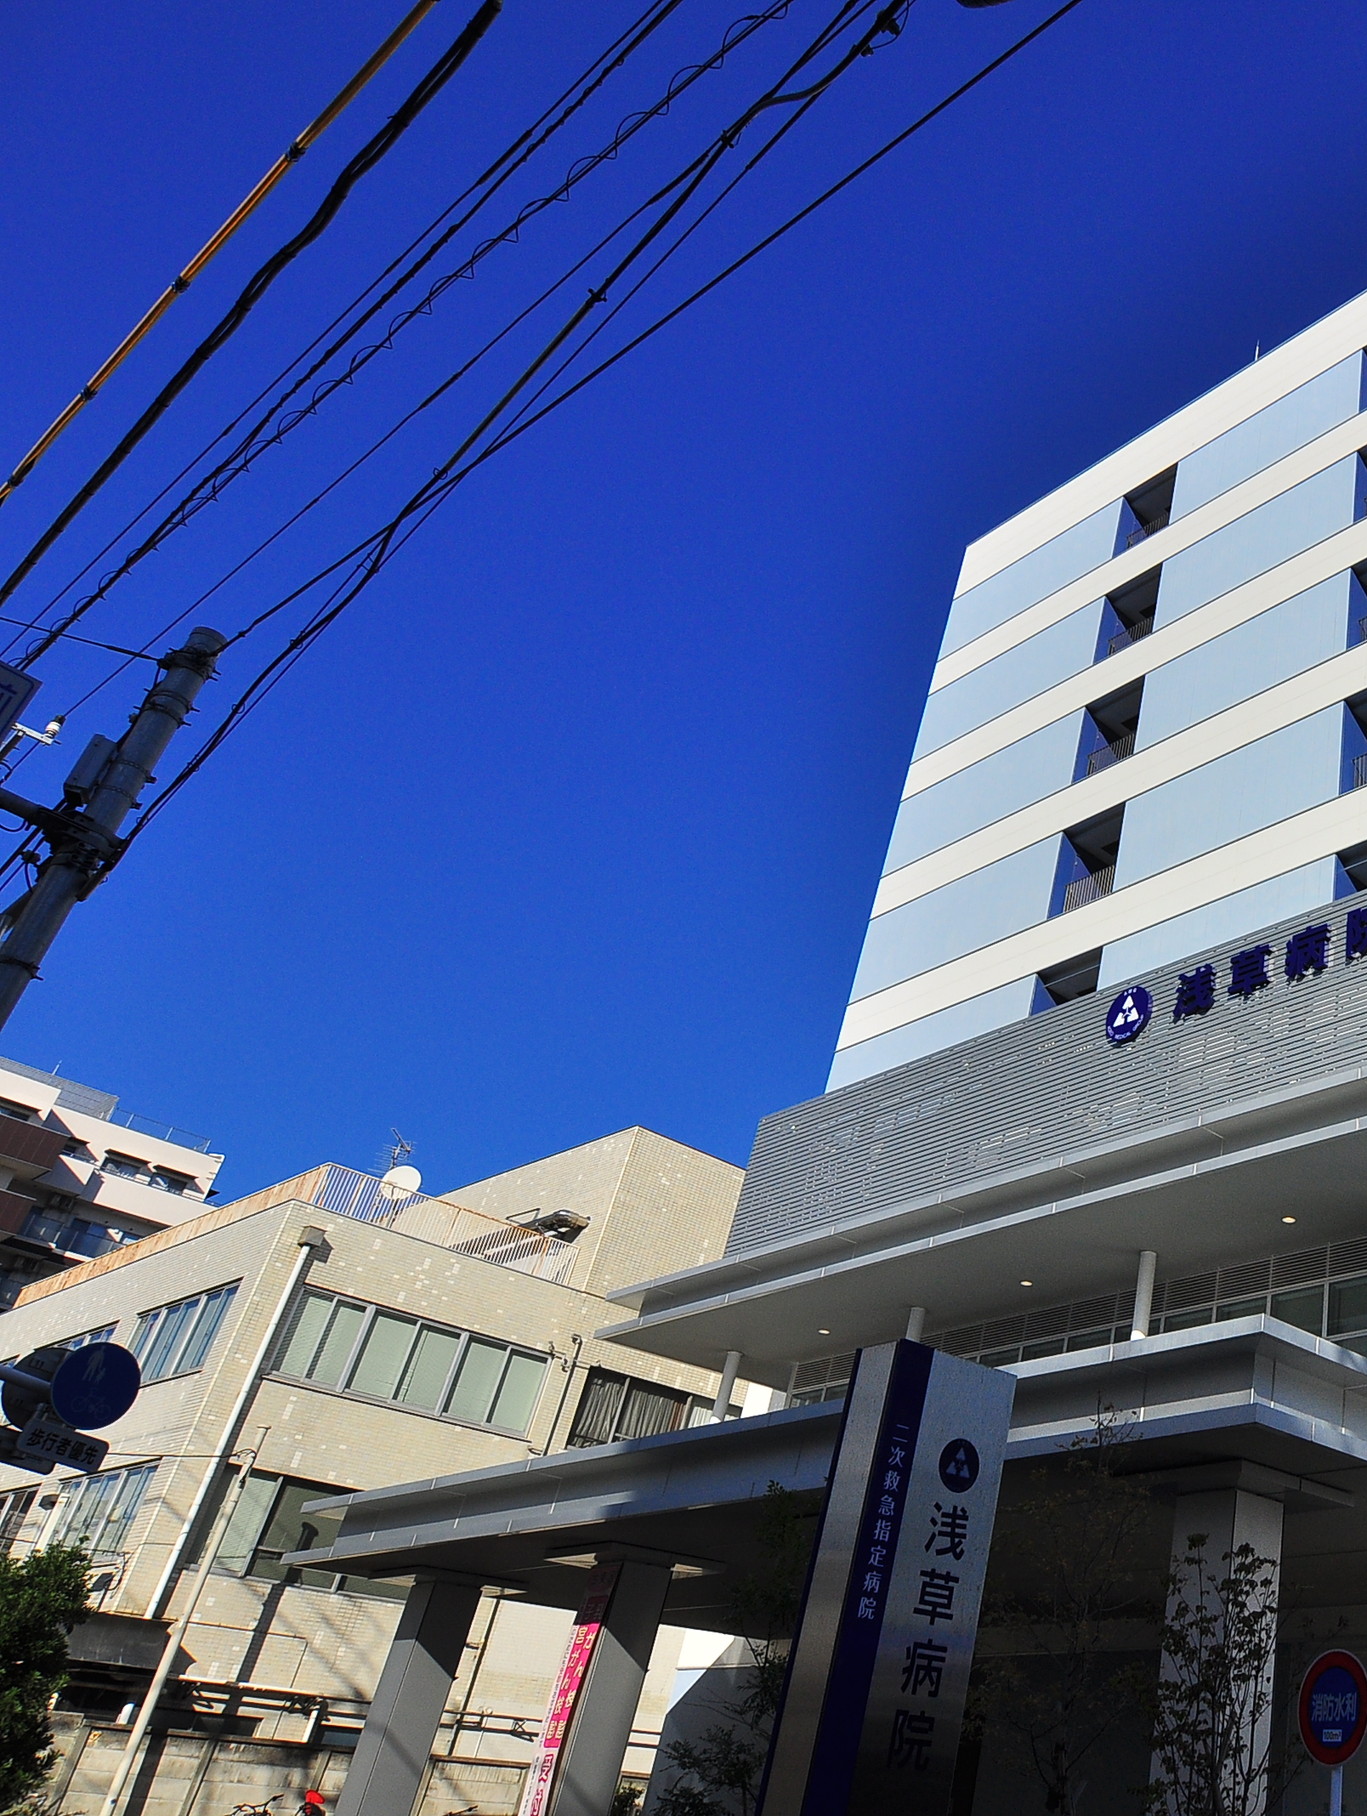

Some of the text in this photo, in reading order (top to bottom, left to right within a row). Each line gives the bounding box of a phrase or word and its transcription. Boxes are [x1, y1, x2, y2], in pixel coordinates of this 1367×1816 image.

[26, 1428, 99, 1465] 歩行者優先
[856, 1424, 910, 1620] 二次救急指定病院
[886, 1502, 970, 1772] 浅草病院
[1311, 1692, 1358, 1722] 消防水利
